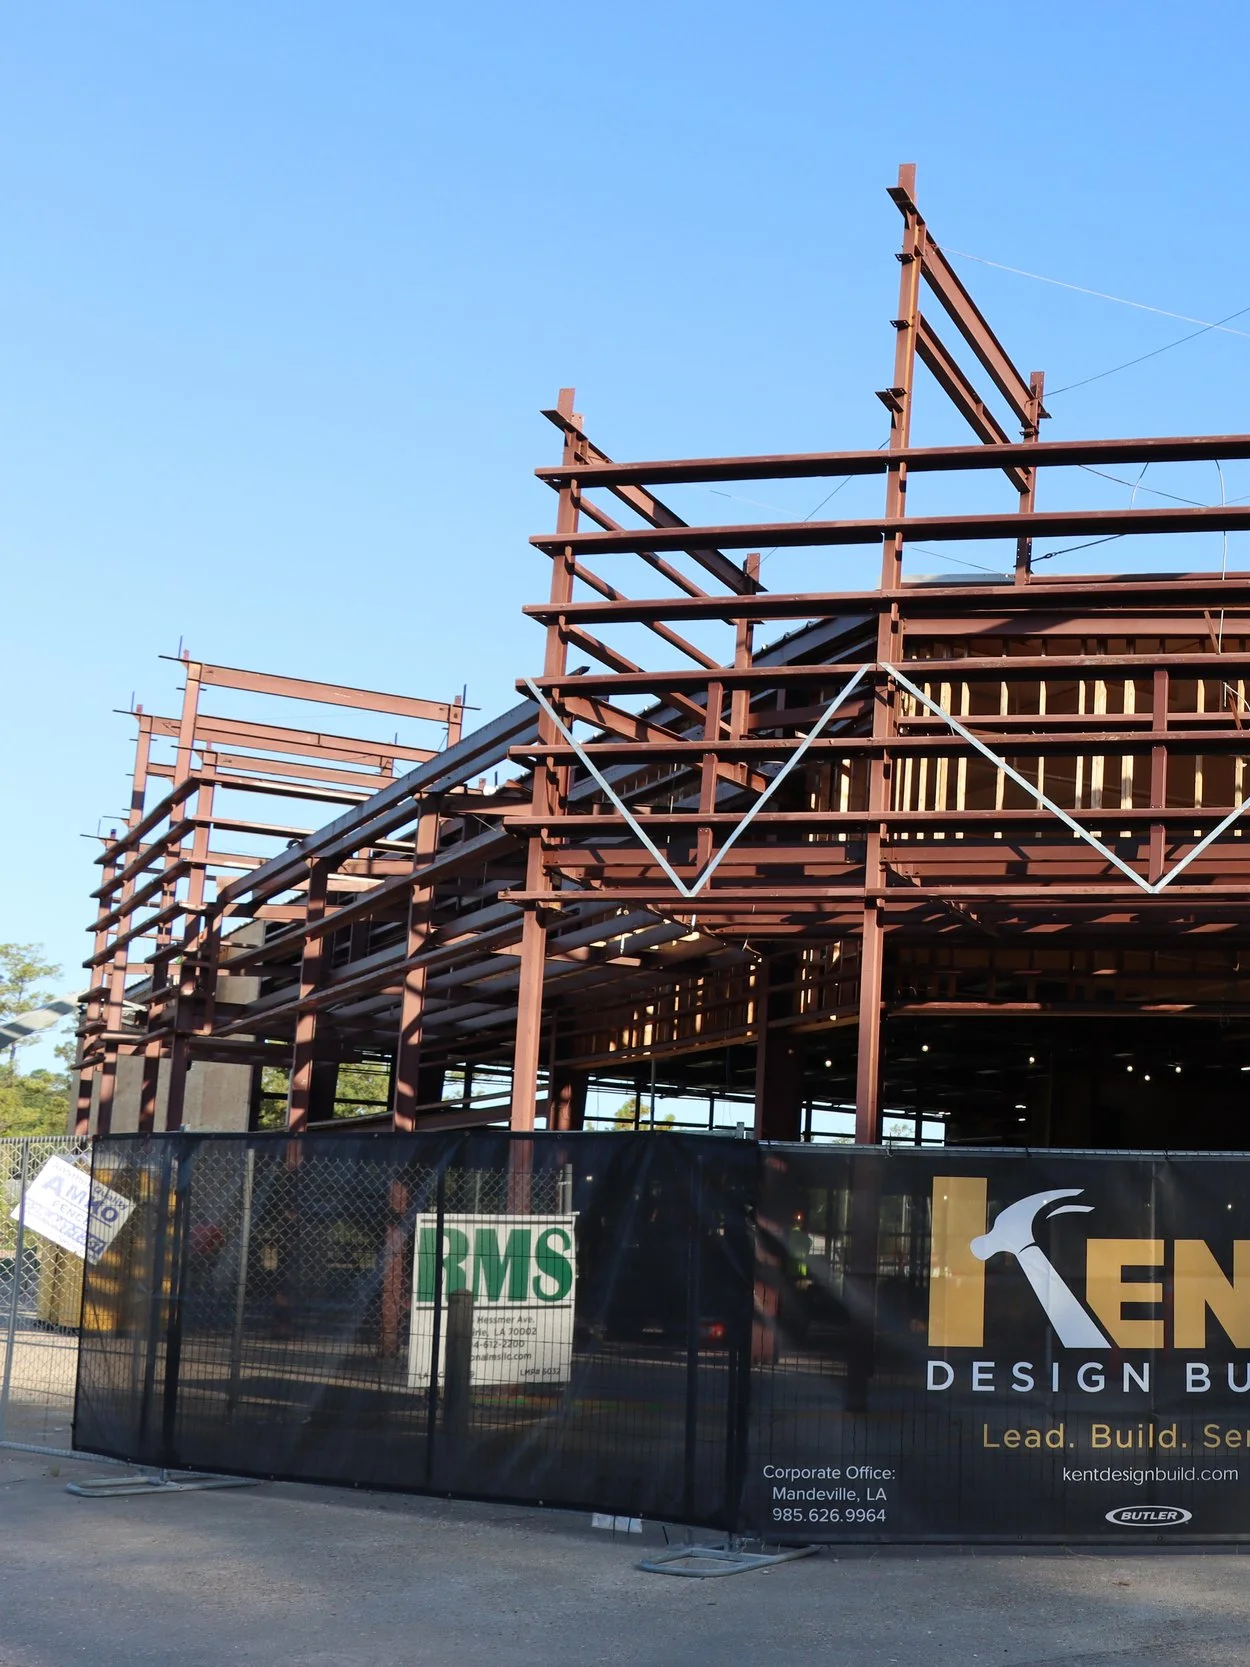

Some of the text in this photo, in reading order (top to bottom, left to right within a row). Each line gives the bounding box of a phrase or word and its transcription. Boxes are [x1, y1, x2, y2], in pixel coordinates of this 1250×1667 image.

[417, 1227, 573, 1303] RMS
[477, 1315, 535, 1325] Hessmer Ave.
[494, 1328, 506, 1337] LA
[509, 1327, 537, 1336] 70002
[472, 1340, 525, 1349] 4-612-2200
[926, 1360, 1151, 1393] DESIGN
[982, 1423, 1075, 1449] Lead.
[1092, 1423, 1187, 1449] Build.
[763, 1465, 896, 1481] Corporate Office:
[1063, 1467, 1239, 1486] kentdesignbuild.com
[772, 1486, 887, 1502] Mandeville, LA
[772, 1507, 887, 1522] 985.626.9964
[1120, 1511, 1178, 1521] BUTLER
